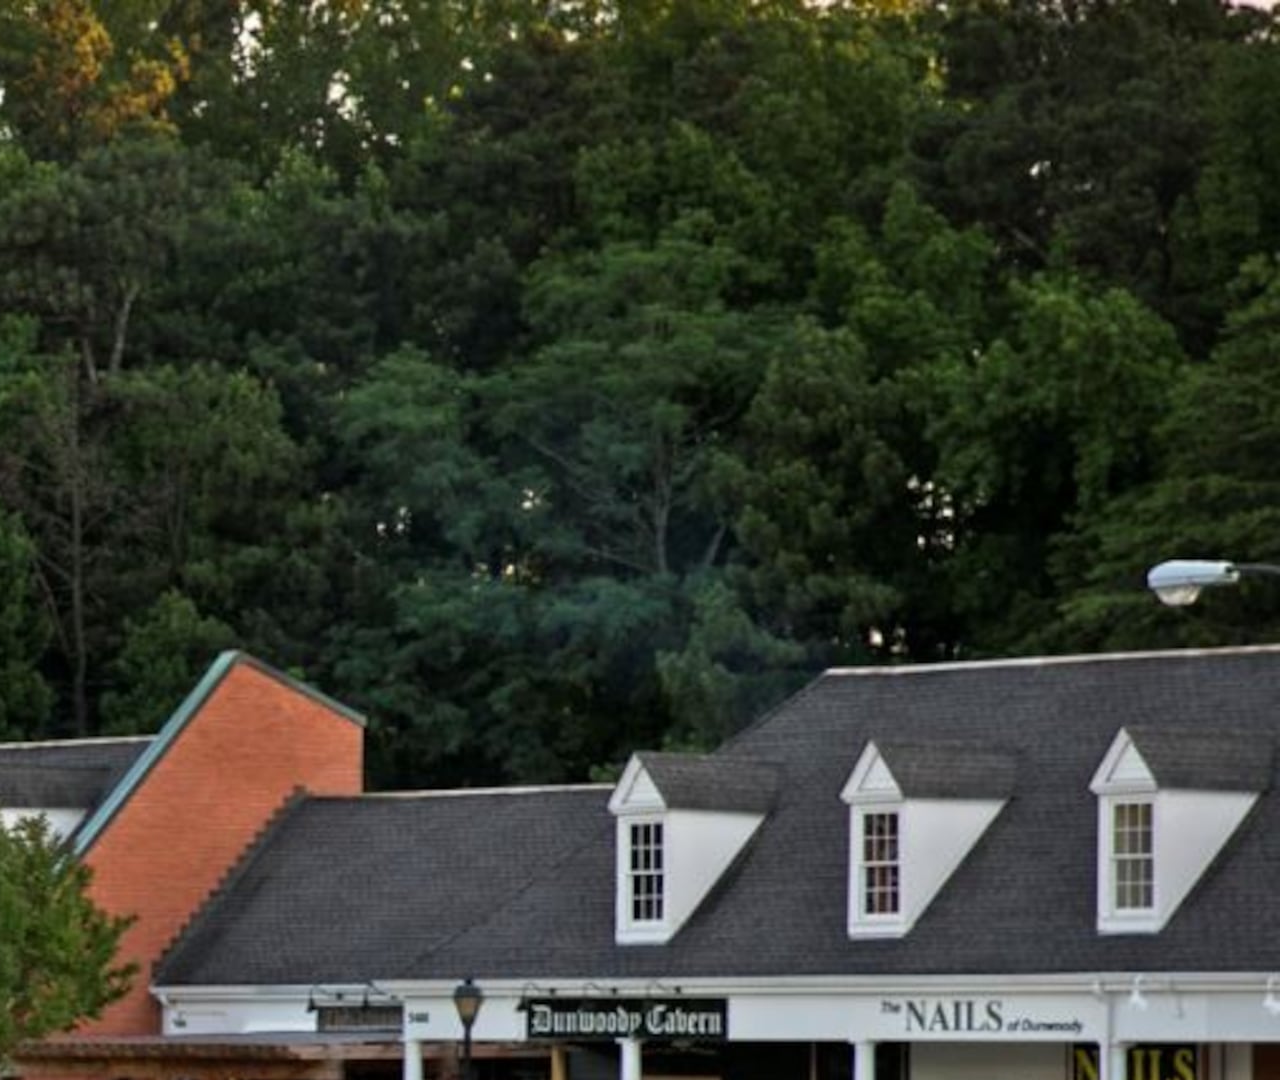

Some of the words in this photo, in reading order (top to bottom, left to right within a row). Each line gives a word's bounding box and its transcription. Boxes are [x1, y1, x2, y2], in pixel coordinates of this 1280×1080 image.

[531, 1004, 641, 1036] Dunwoody
[646, 1004, 722, 1034] Tavern
[905, 1001, 1003, 1032] NAILS
